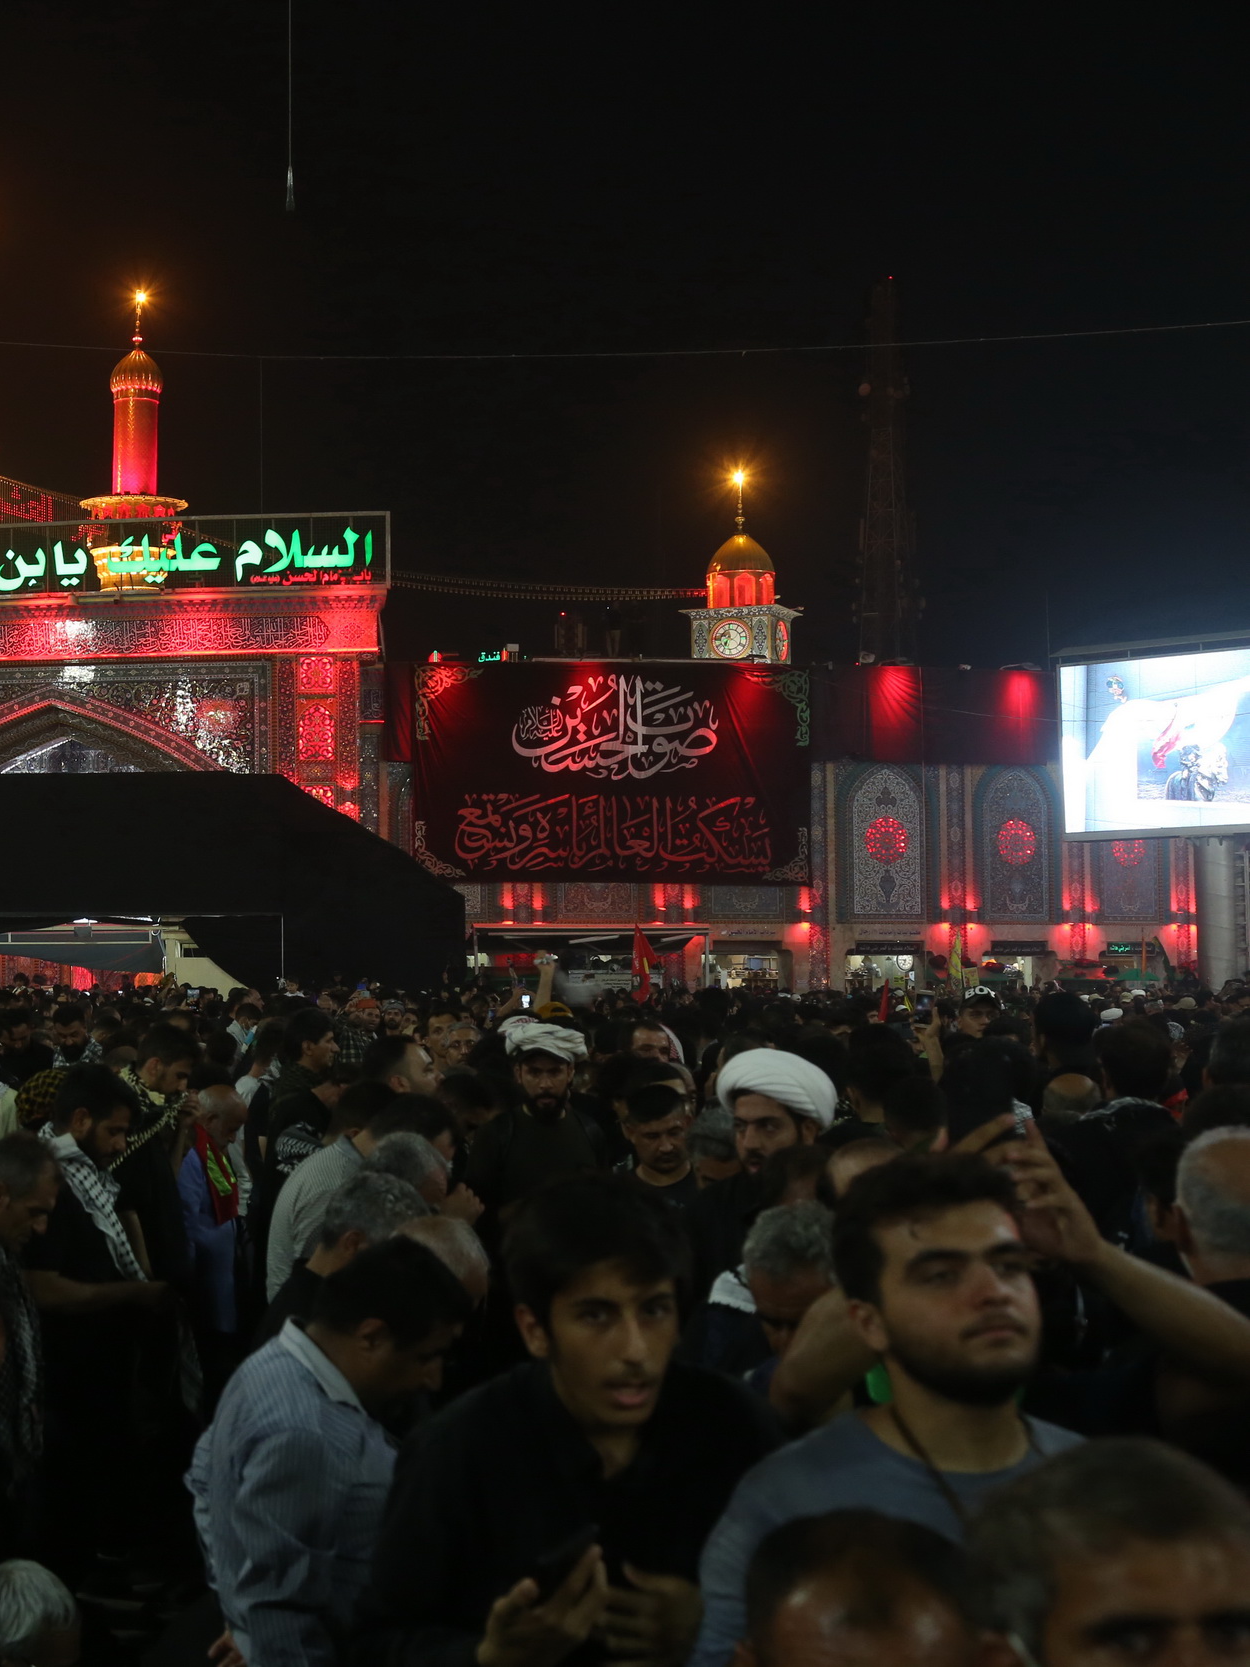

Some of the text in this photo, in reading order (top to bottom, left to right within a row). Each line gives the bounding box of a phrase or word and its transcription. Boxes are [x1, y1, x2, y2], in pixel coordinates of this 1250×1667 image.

[106, 533, 222, 581] عليك
[234, 527, 373, 582] السلام
[478, 651, 501, 663] فندق
